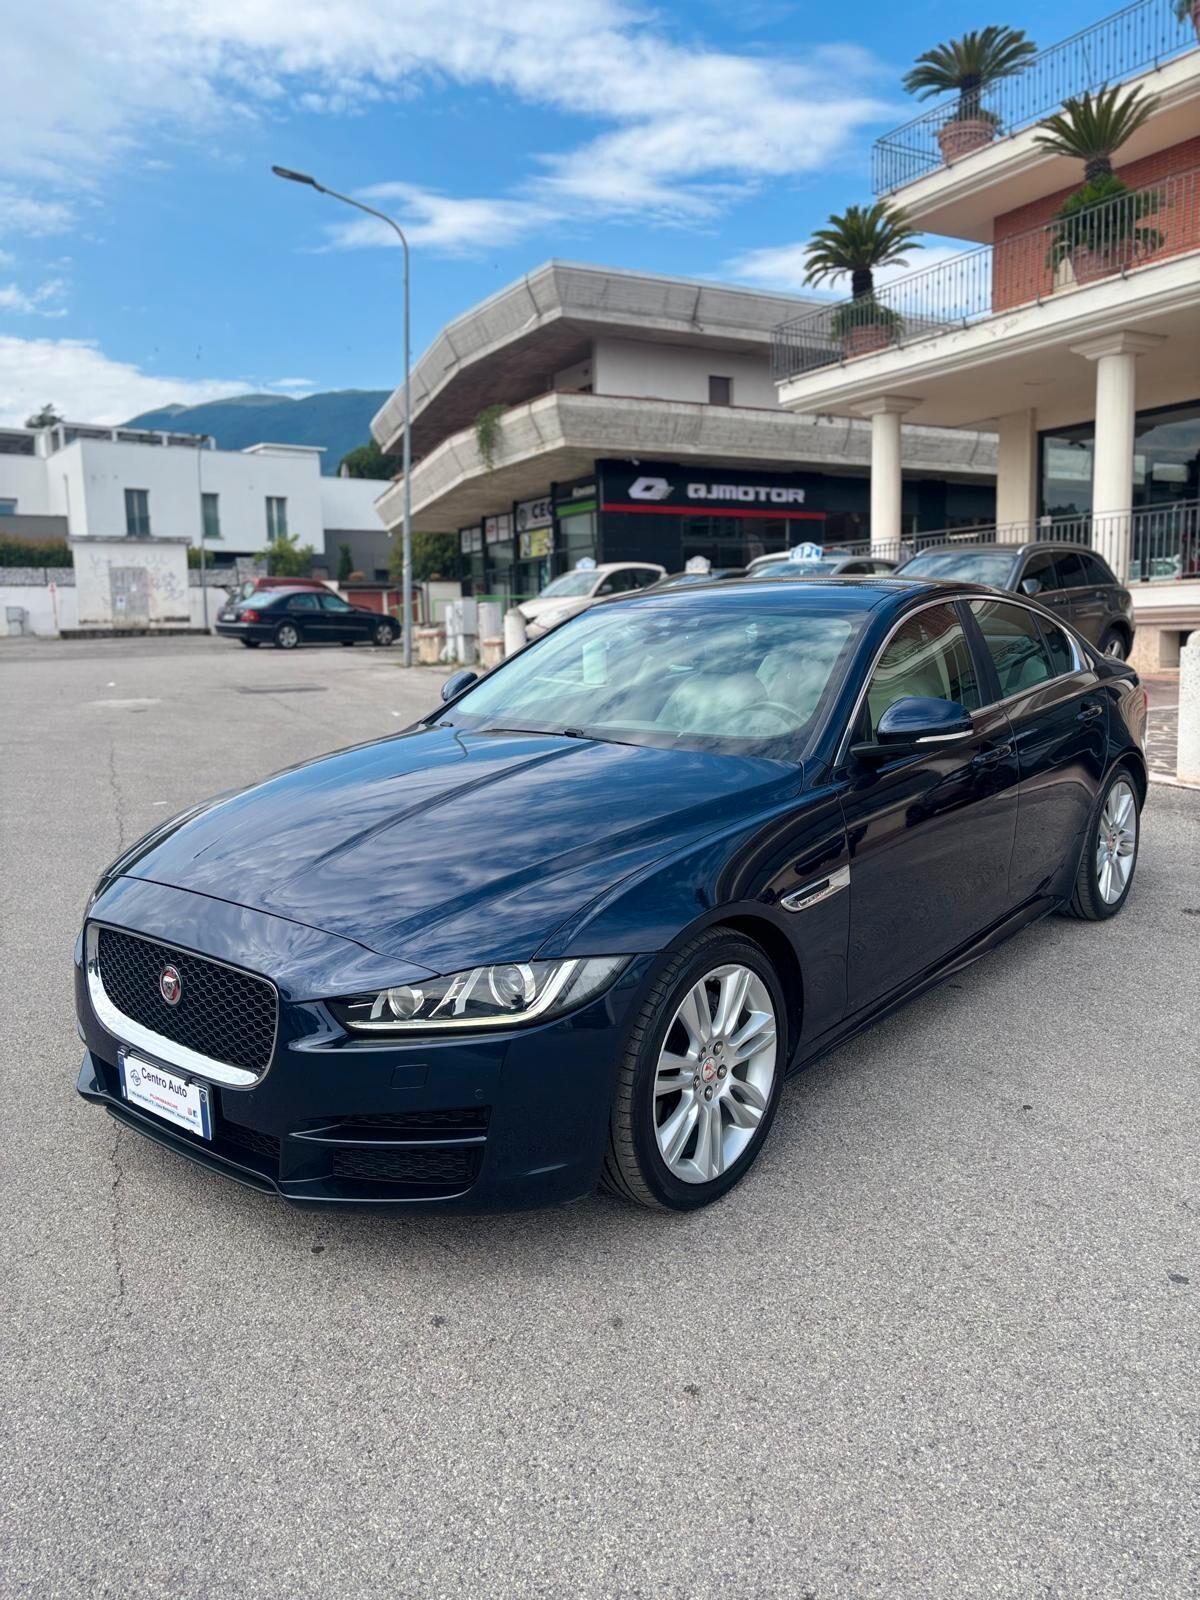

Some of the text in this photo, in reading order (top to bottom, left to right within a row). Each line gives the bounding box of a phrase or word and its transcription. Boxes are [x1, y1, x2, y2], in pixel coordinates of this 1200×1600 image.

[687, 483, 805, 503] QJMOTOR
[141, 1067, 167, 1088] Centro
[168, 1080, 187, 1098] Auto
